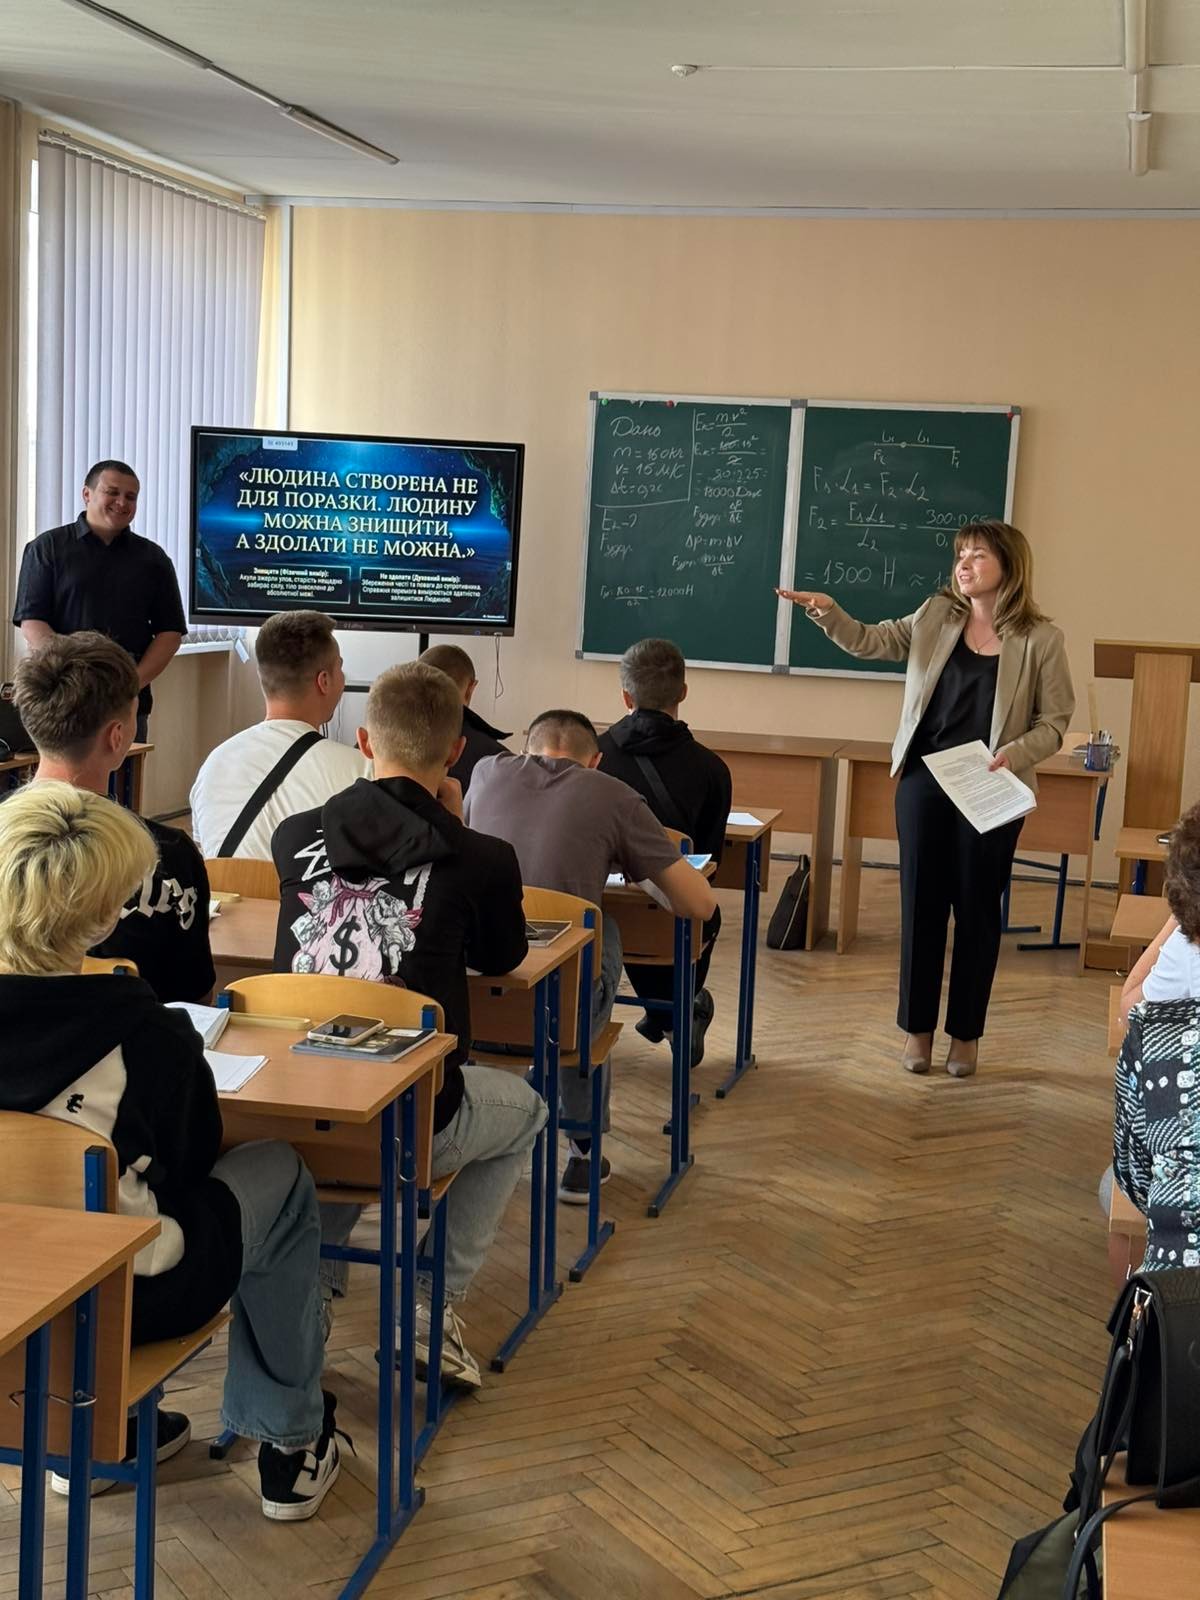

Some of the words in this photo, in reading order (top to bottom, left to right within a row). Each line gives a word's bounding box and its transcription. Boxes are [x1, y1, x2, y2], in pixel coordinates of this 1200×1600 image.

[610, 416, 661, 437] Дано
[239, 467, 340, 488] «ЛЮДИНА
[345, 472, 448, 494] СТВОРЕНА
[453, 477, 478, 495] НЕ
[237, 489, 279, 508] ДЛЯ
[285, 491, 382, 512] ПОРАЗКИ.
[387, 497, 477, 517] ЛЮДИНУ
[263, 512, 343, 532] МОЖНА
[348, 516, 454, 539] ЗНИЩИТИ,
[236, 533, 250, 549] А
[254, 534, 347, 555] ЗДОЛАТИ
[352, 538, 378, 555] НЕ
[383, 540, 476, 559] МОЖНА.»
[823, 559, 872, 585] 1500
